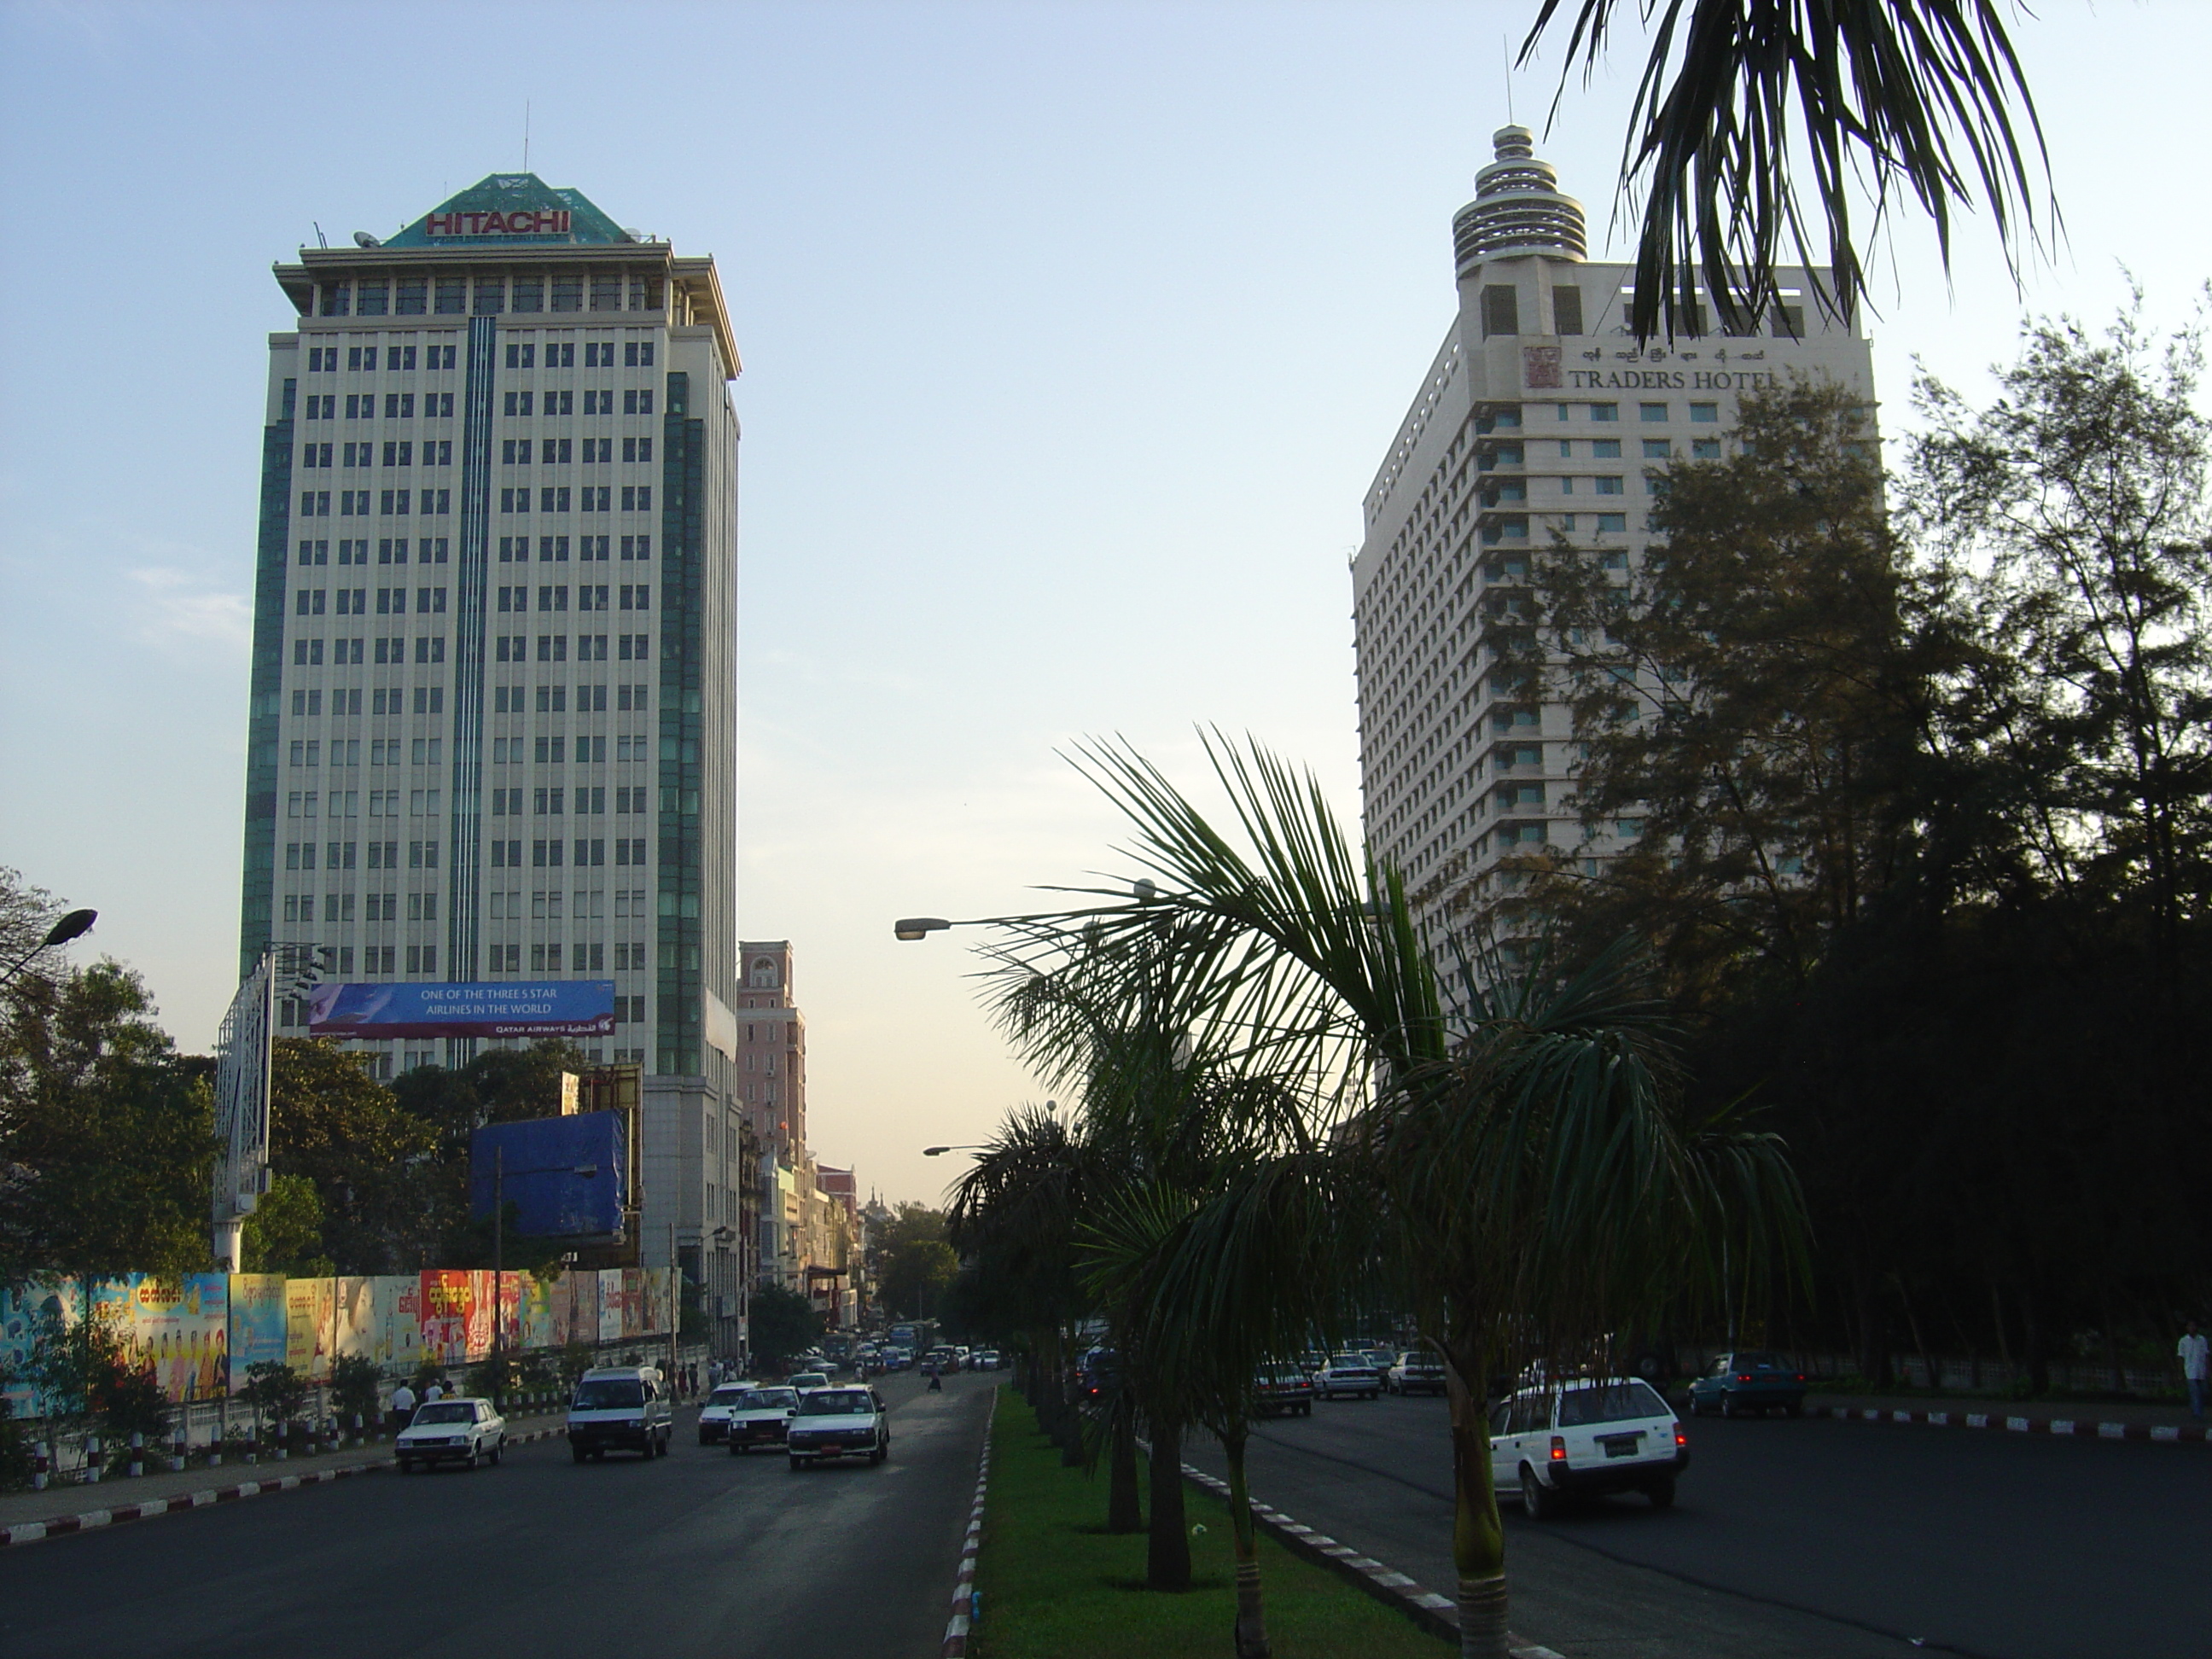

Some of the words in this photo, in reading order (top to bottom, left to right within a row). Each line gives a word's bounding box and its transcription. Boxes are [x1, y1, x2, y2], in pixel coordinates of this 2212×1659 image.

[427, 211, 569, 235] HITACHI
[1568, 370, 1685, 389] TRADERS
[1694, 370, 1780, 390] HOTEL
[421, 990, 443, 1000] ONE
[446, 990, 461, 999] OF
[464, 989, 484, 999] THE
[486, 989, 519, 999] THREE
[530, 988, 557, 998] STAR
[426, 1004, 471, 1015] AIRLINES
[474, 1004, 485, 1014] IN
[487, 1004, 508, 1014] THE
[510, 1004, 551, 1014] WORLD
